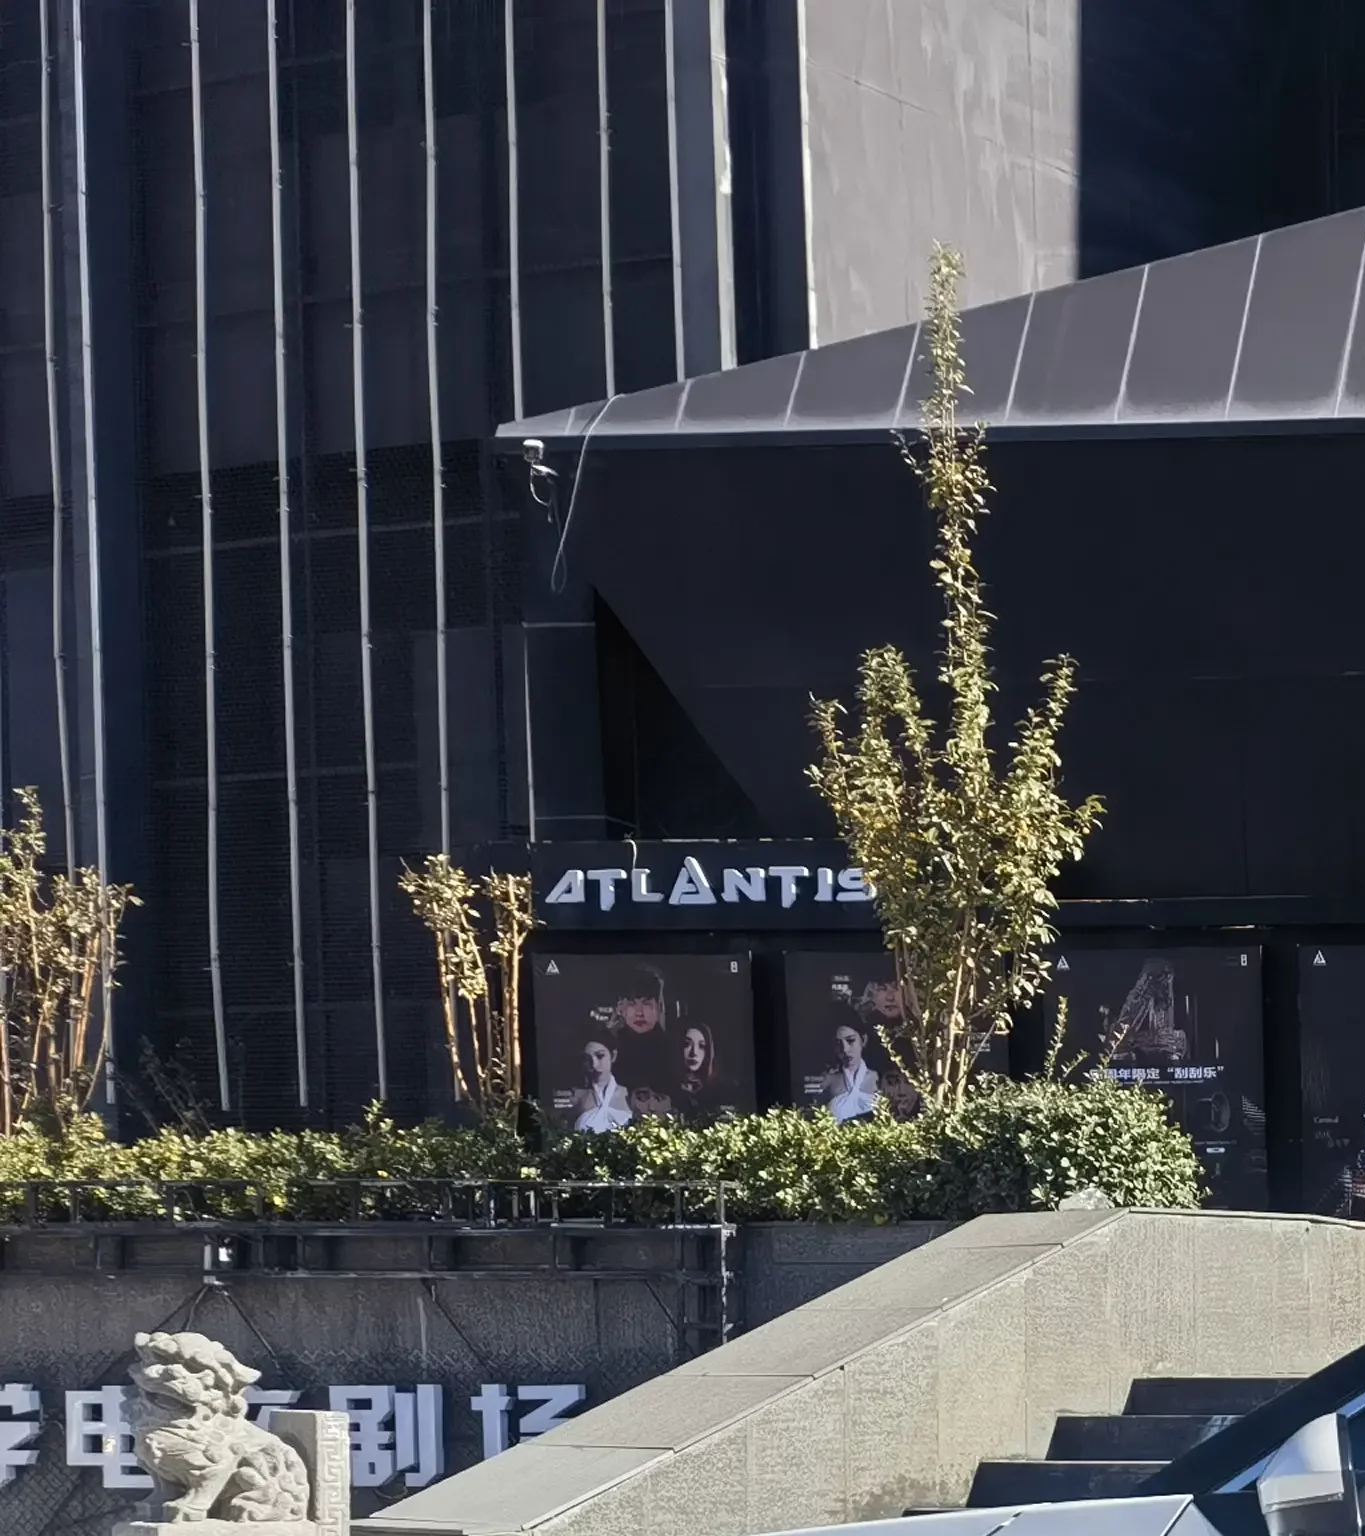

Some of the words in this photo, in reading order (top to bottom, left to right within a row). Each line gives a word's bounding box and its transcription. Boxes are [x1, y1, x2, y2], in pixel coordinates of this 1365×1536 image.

[545, 856, 878, 911] ATLANTIS
[0, 1383, 586, 1489] 电剧场
